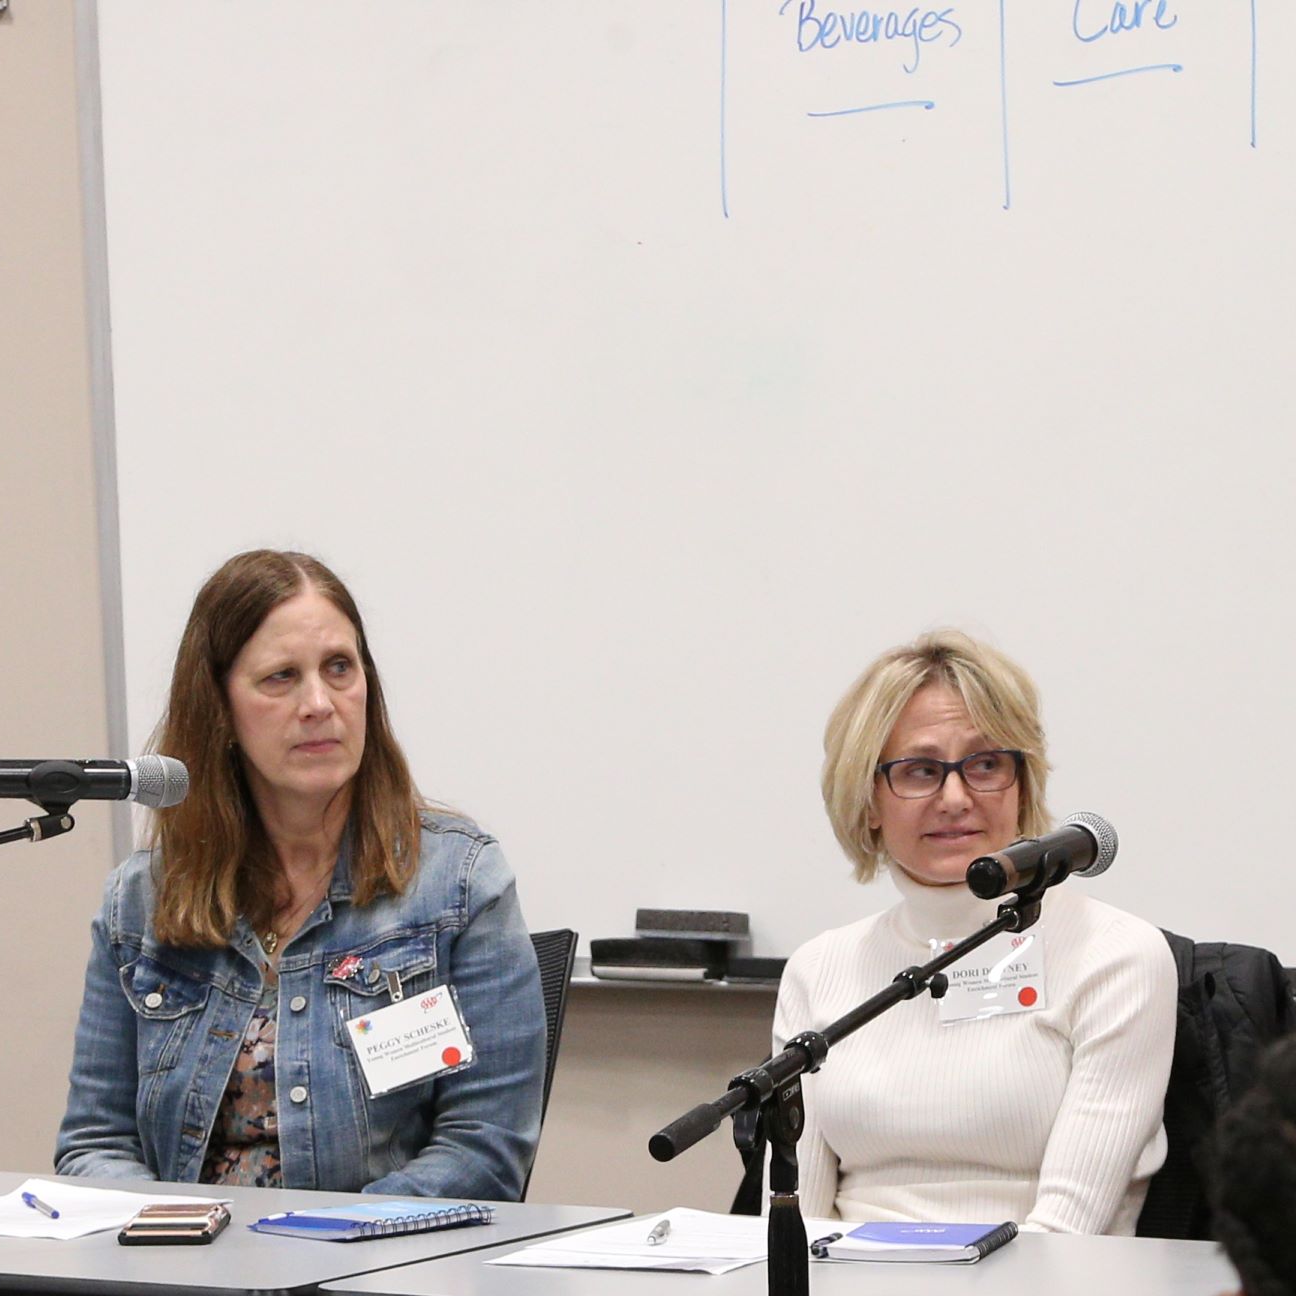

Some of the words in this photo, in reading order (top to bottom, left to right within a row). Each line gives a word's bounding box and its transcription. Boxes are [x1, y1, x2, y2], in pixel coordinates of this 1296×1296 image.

[780, 0, 963, 74] Beverages
[952, 968, 979, 979] DORI
[366, 1035, 401, 1055] PEGGY
[403, 1017, 449, 1040] SCHESKE
